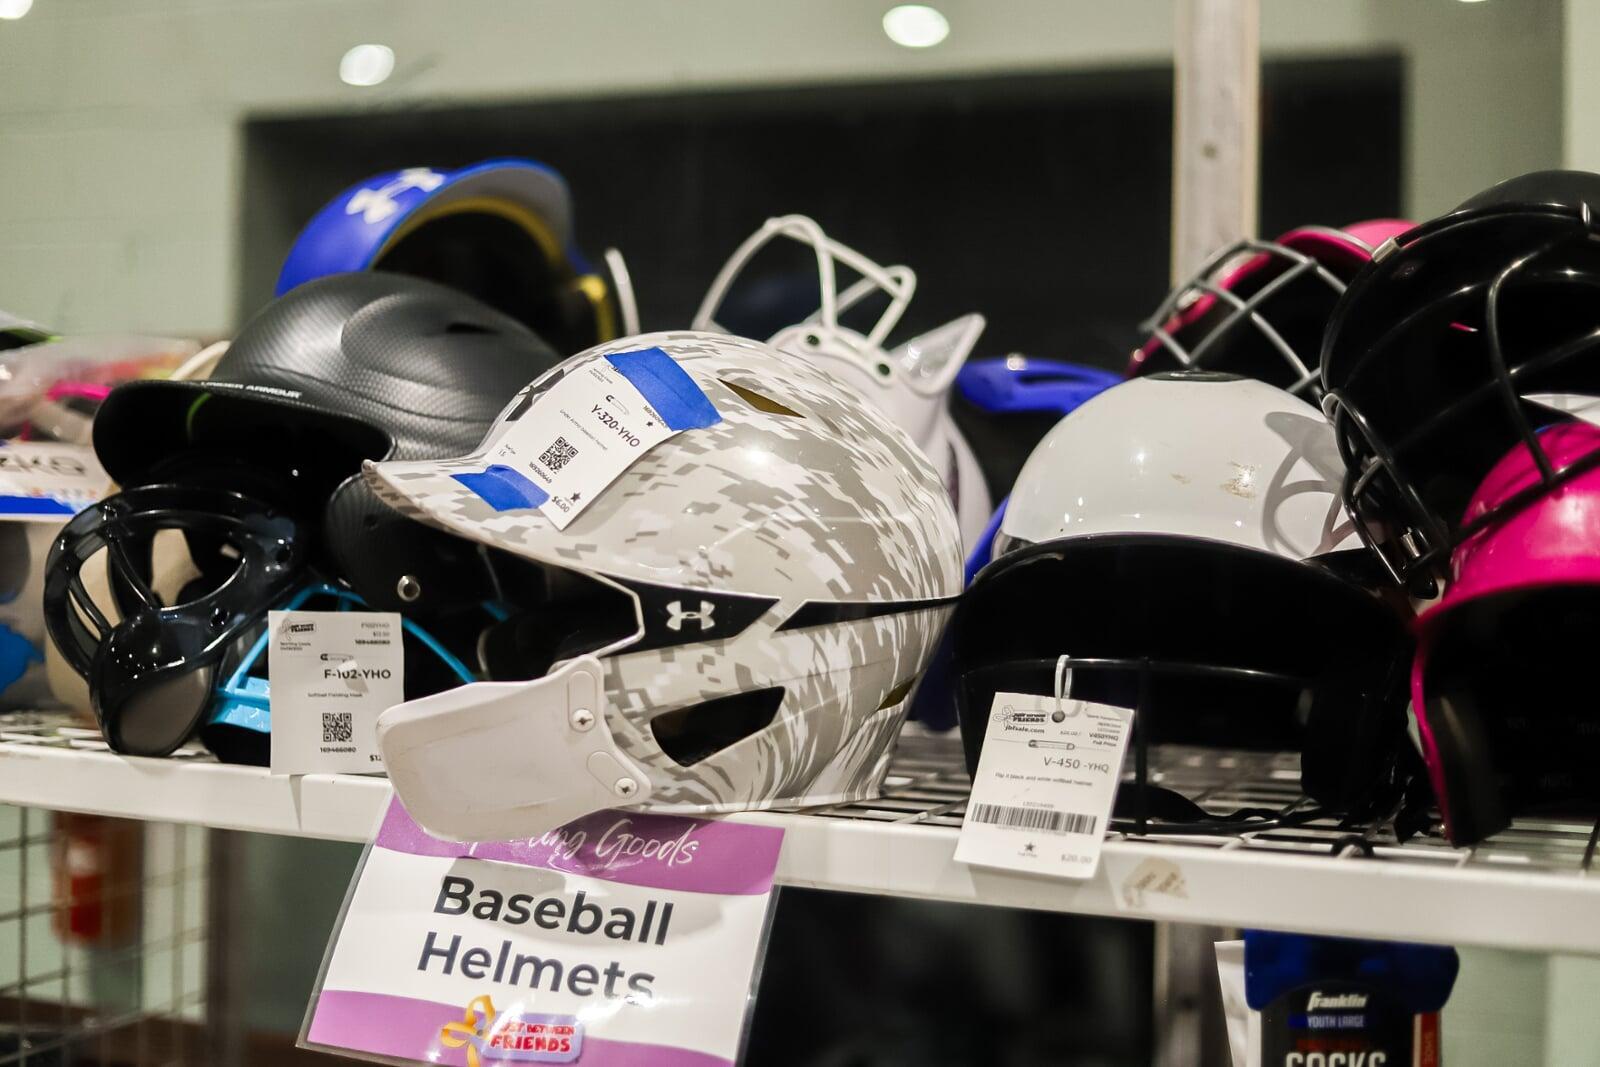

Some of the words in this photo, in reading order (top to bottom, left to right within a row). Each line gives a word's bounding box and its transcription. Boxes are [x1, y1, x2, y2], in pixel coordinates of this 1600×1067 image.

[591, 404, 641, 448] Y-320-YHO
[551, 496, 570, 513] $6.00
[324, 668, 392, 680] F-102-YHO
[1005, 725, 1045, 734] jbfsale.com
[1044, 756, 1081, 770] V-450
[596, 818, 700, 867] Goods
[433, 874, 674, 946] Baseball
[416, 930, 657, 1007] Helmets
[1307, 1015, 1336, 1028] YOUTH
[1338, 1015, 1364, 1028] LARGE
[490, 1035, 571, 1052] FRIENDS
